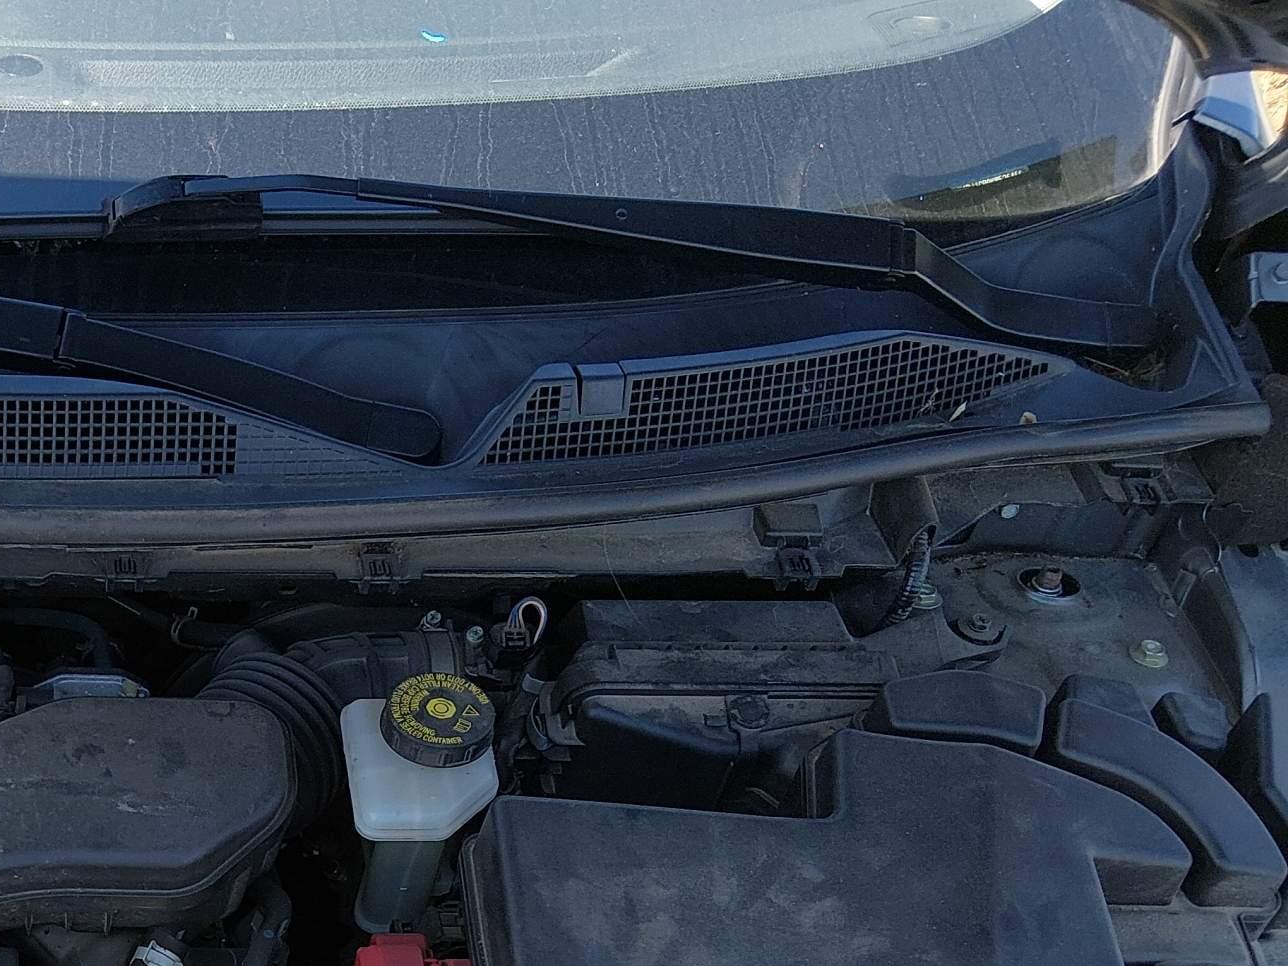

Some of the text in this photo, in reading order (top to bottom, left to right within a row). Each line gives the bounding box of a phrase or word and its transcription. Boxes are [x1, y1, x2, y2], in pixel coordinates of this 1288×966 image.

[436, 673, 446, 681] OR
[419, 680, 441, 690] FILLER
[441, 680, 465, 694] CLEAN
[399, 722, 423, 739] SEALED
[404, 714, 436, 736] REMOVING
[422, 735, 463, 745] CONTAINER
